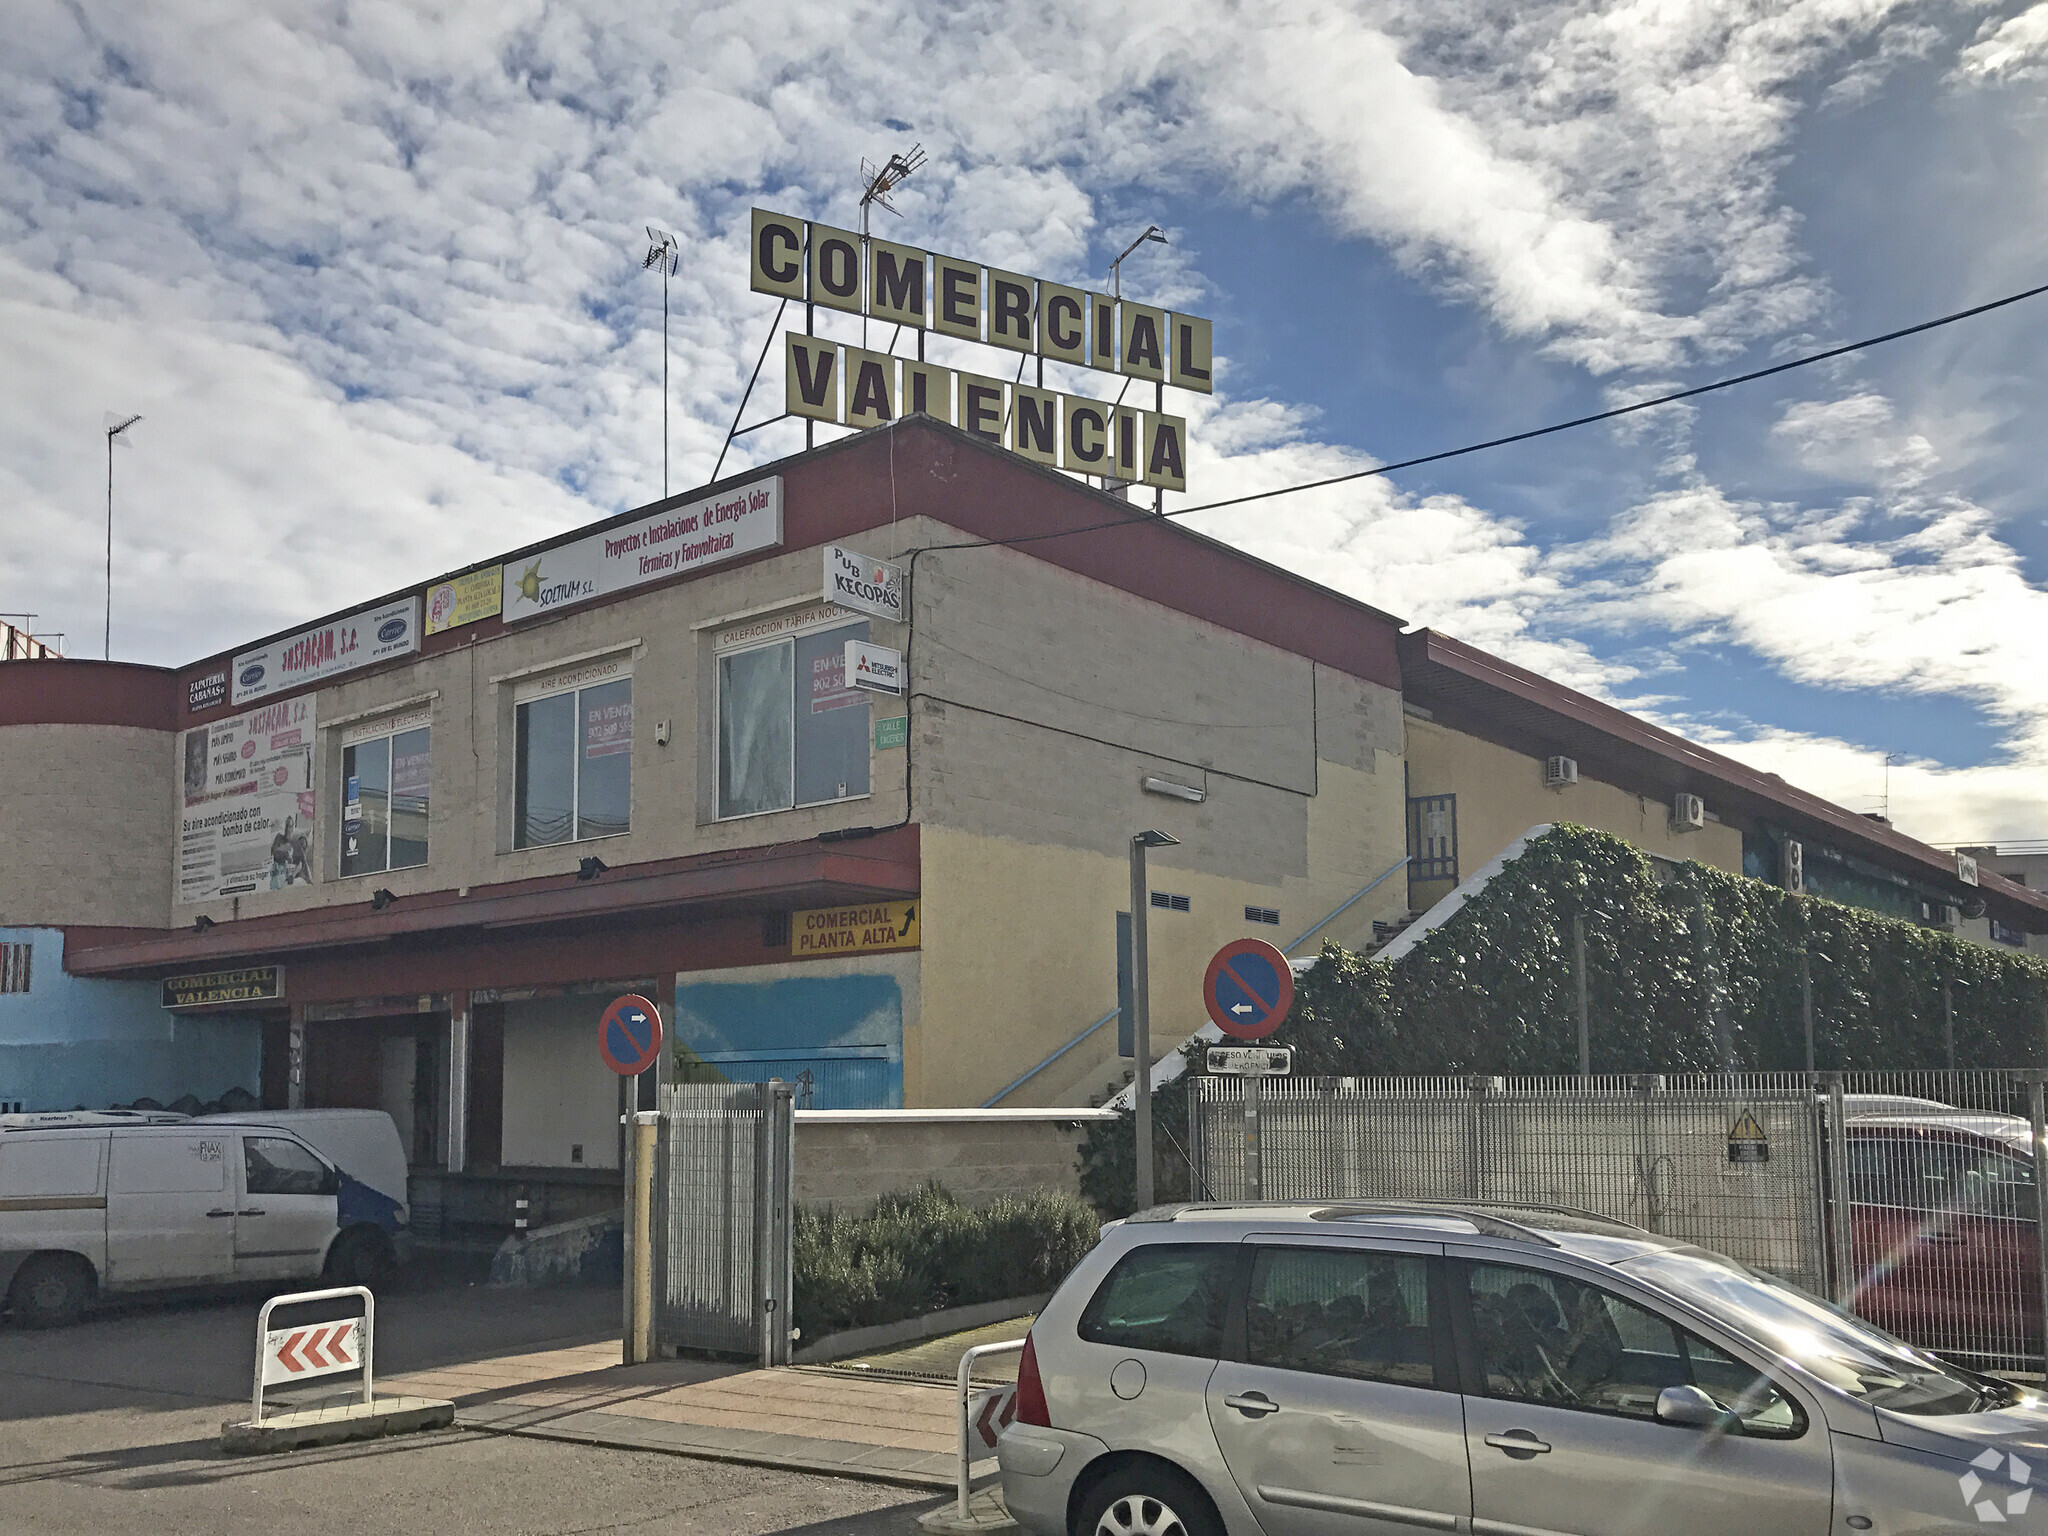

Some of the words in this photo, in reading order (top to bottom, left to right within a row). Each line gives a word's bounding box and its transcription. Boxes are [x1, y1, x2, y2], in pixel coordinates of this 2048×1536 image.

[759, 223, 1210, 381] COMERCIAL
[792, 344, 1184, 480] VALENCIA
[605, 531, 641, 559] Proyectos
[642, 534, 647, 546] e
[649, 514, 698, 544] Instalaciones
[703, 507, 713, 527] de
[715, 496, 746, 523] Energía
[749, 489, 770, 514] Solar
[639, 552, 673, 576] Térmicas
[674, 549, 680, 570] y
[682, 532, 734, 563] Fotovoltaicas
[835, 548, 860, 577] PUB
[540, 580, 580, 607] SOLTIUM
[835, 573, 899, 609] KECOPAS
[724, 620, 782, 644] CALEFACCION
[785, 612, 816, 627] TARIFA
[541, 679, 556, 689] AIRE
[558, 664, 618, 686] ACONDICIONADO
[814, 660, 829, 673] EN
[871, 661, 898, 674] MITSUBISHI
[871, 668, 894, 678] ELECTRIC
[190, 673, 225, 692] ZAPATERIA
[814, 677, 830, 691] 902
[190, 685, 220, 704] CABAÑAS
[353, 718, 395, 738] INSTALACIONES
[396, 710, 431, 727] ELECTRICAS
[589, 710, 600, 722] EN
[883, 721, 900, 731] CALLE
[183, 820, 191, 831] Su
[192, 817, 203, 830] aire
[204, 807, 248, 827] acondicionado
[249, 807, 261, 818] con
[222, 822, 242, 837] bomba
[244, 820, 252, 833] de
[806, 908, 891, 930] COMERCIAL
[800, 930, 855, 950] PLANTA
[862, 927, 896, 945] ALTA
[168, 969, 272, 990] COMERCIAL
[176, 986, 262, 1004] VALENCIA
